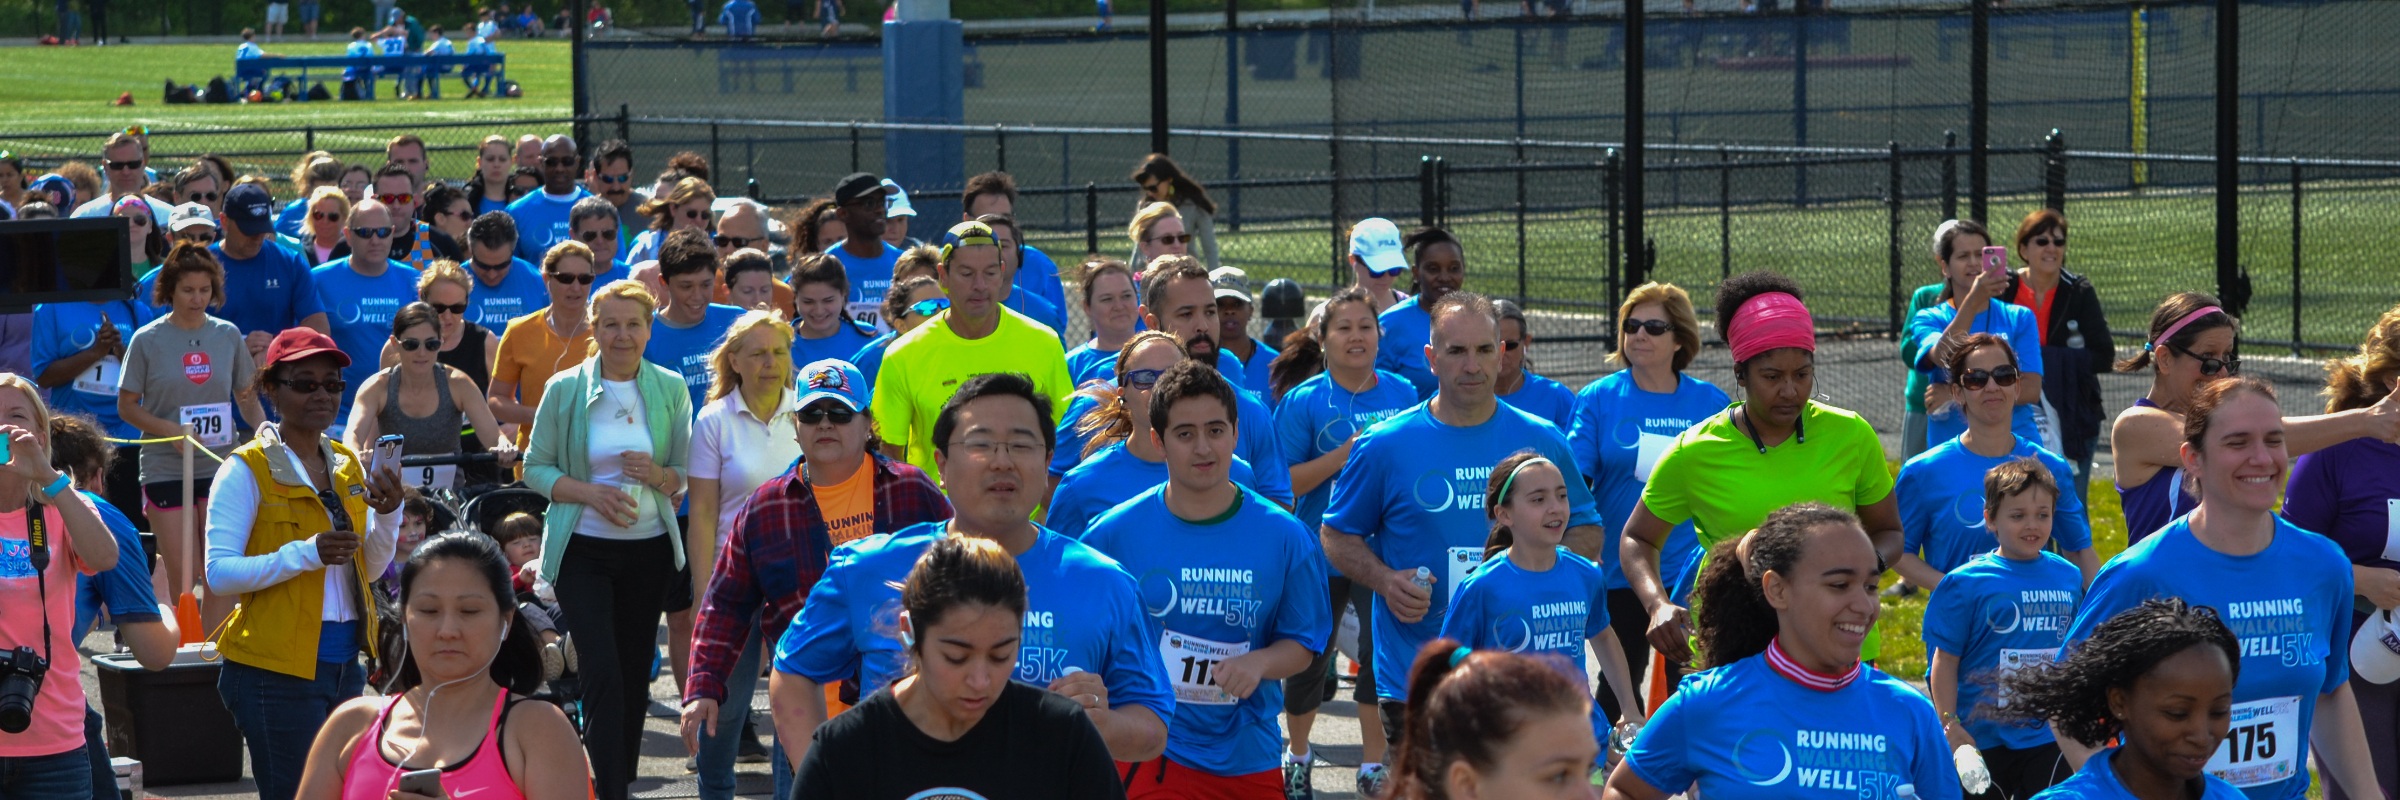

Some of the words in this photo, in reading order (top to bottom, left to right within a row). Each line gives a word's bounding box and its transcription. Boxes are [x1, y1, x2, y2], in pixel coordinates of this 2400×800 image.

[863, 280, 891, 289] RUNNI
[361, 297, 399, 306] RUNNING
[484, 297, 522, 306] RUNNING
[362, 313, 387, 323] WELL
[95, 364, 102, 382] 1
[191, 414, 222, 435] 379
[1645, 417, 1692, 428] RUNNING
[422, 466, 434, 486] 9
[1455, 466, 1495, 480] RUNN
[825, 511, 873, 531] RUNNIN
[33, 518, 43, 547] Nikon
[830, 523, 873, 541] WALKIN
[1181, 567, 1253, 584] RUNNING
[1181, 583, 1253, 598] WALKING
[2021, 590, 2072, 603] RUNNIN
[1180, 597, 1225, 615] WELL
[1225, 598, 1262, 629] 5K
[1532, 600, 1586, 619] RUNNING
[2022, 602, 2072, 615] WALKIN
[2228, 598, 2303, 619] RUNNING
[2022, 616, 2058, 632] WELL
[2229, 616, 2304, 636] WALKING
[1183, 639, 1209, 650] RUNNING
[1533, 631, 1572, 650] WELL
[1209, 645, 1229, 656] WELL
[2281, 632, 2320, 668] 5K
[1021, 646, 1068, 683] 5K
[2252, 705, 2274, 718] WELL
[1797, 729, 1886, 752] RUNNING
[2223, 721, 2277, 764] 175
[1797, 748, 1886, 771] WALKING
[1797, 766, 1857, 791] WELL
[1858, 770, 1900, 800] 5K
